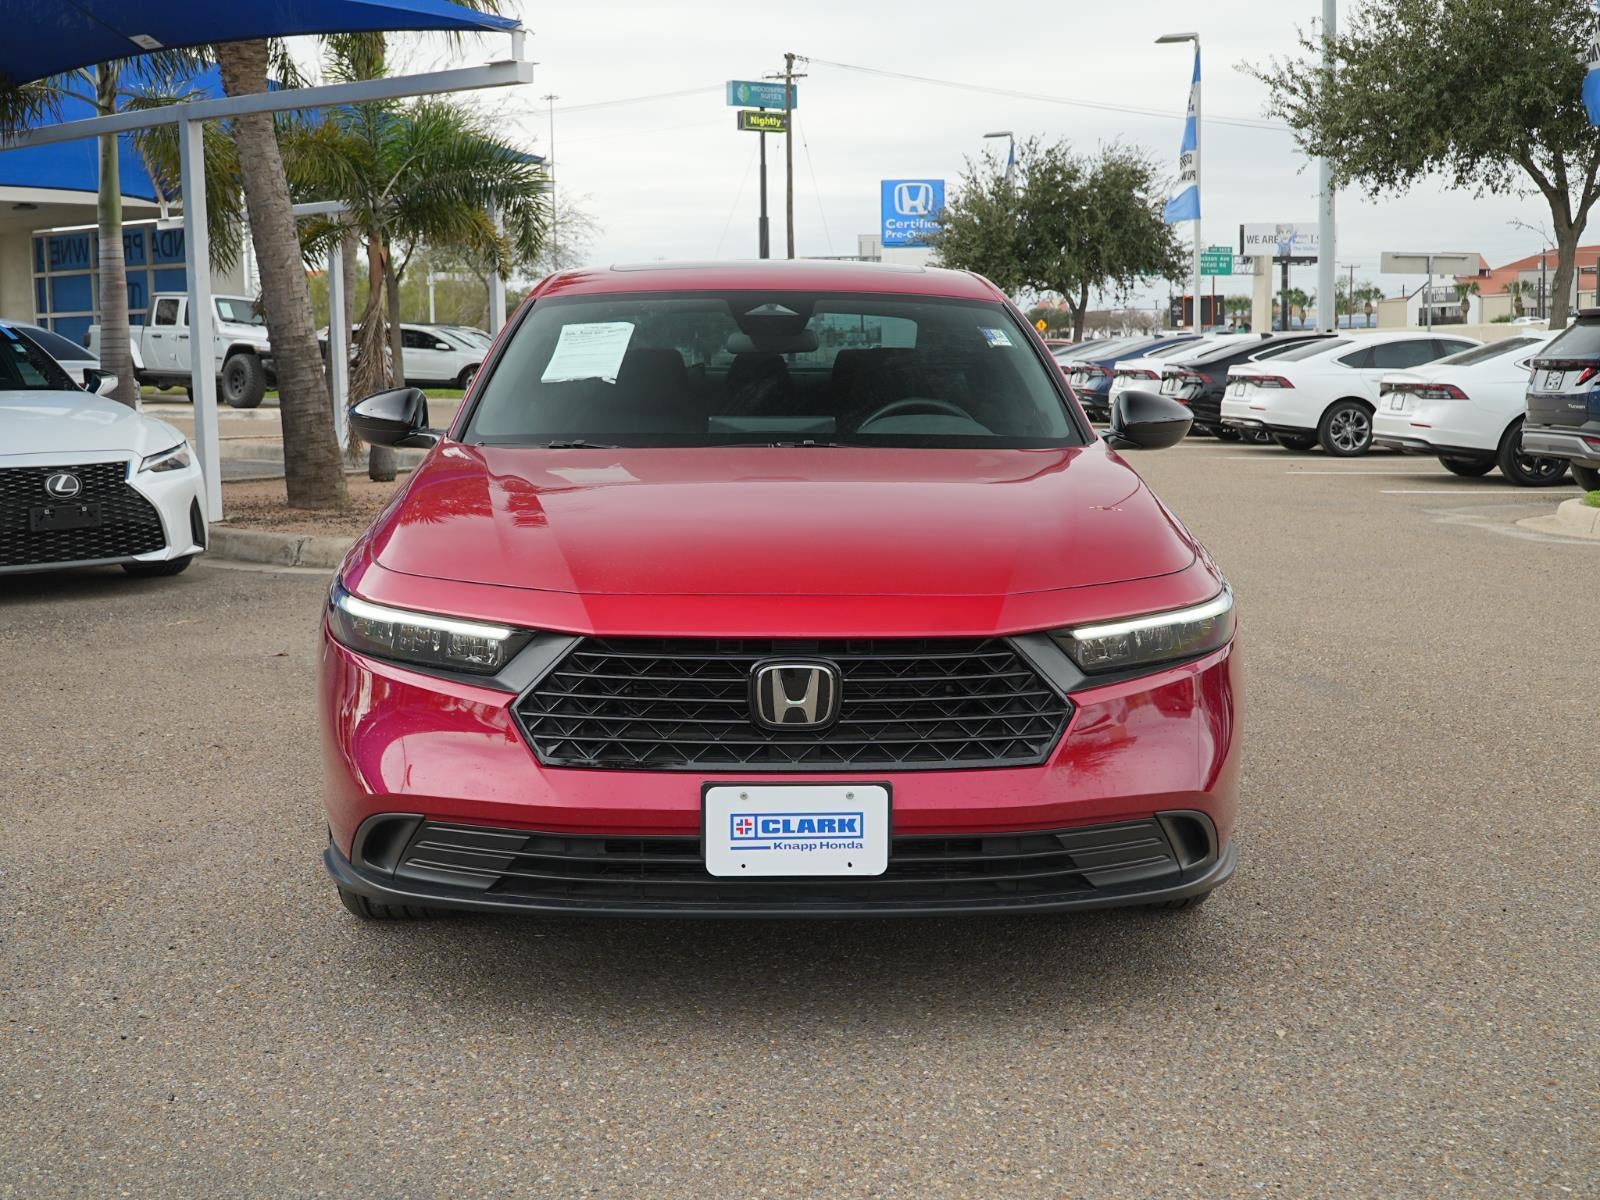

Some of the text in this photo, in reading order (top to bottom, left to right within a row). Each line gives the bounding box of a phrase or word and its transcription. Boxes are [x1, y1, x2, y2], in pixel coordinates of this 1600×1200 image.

[751, 116, 781, 127] Nightly
[1246, 235, 1278, 244] WE ARE
[761, 818, 857, 834] CLARK
[773, 841, 863, 851] Knapp Honda
